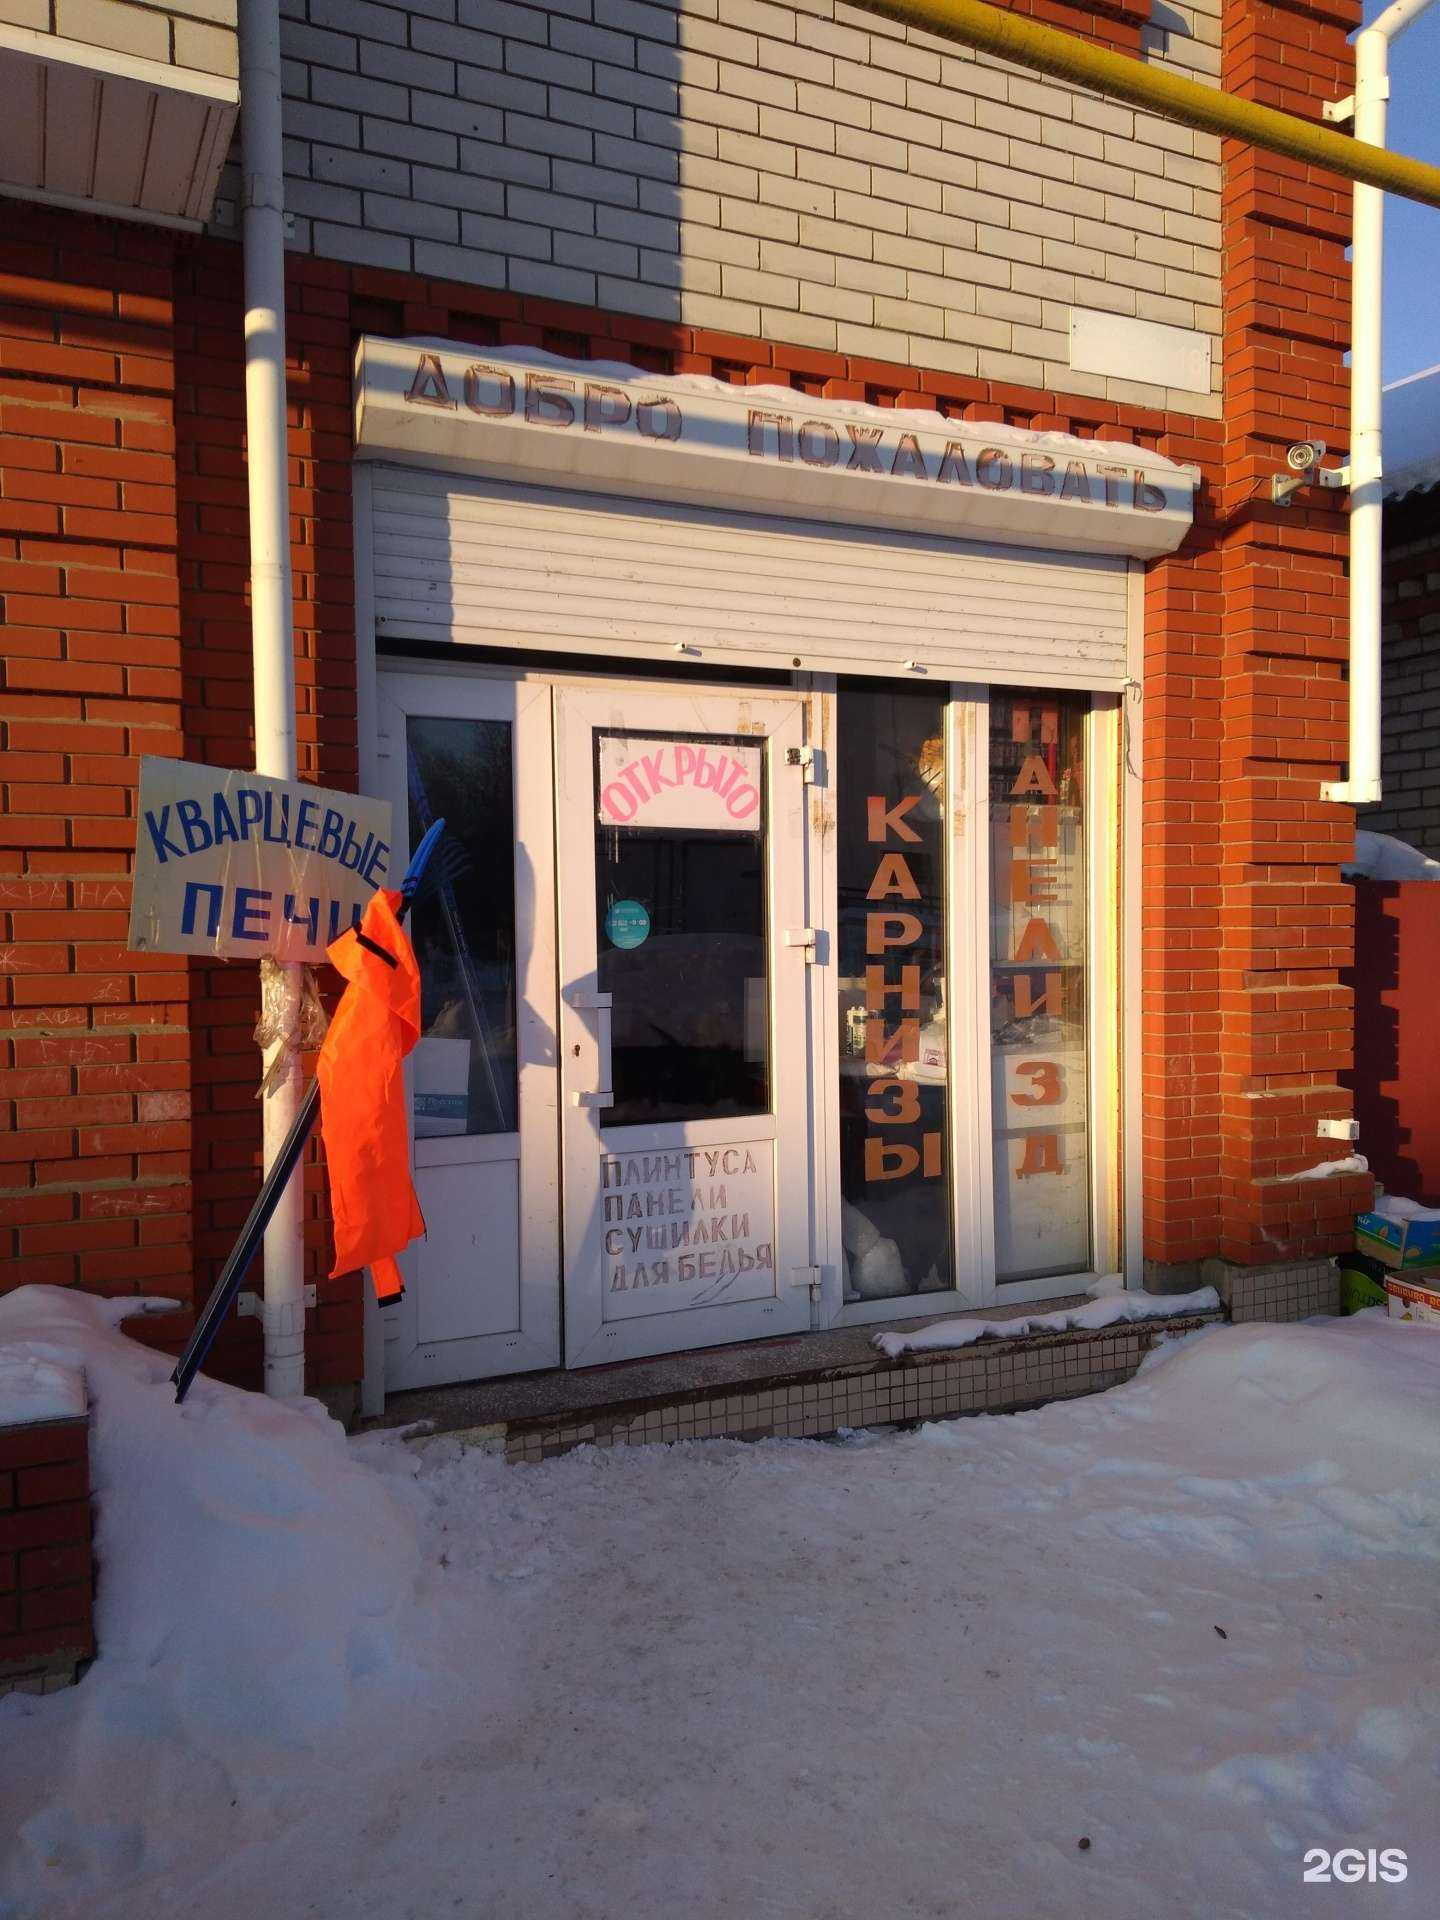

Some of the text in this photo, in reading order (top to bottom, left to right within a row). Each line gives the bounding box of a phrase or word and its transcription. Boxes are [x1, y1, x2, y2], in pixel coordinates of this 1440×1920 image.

[404, 353, 1167, 513] ДОБРО ПОЖАЛОВАТЬ
[602, 745, 759, 822] ОТКРЫТО
[145, 789, 390, 890] КВАРЦЕВЫЕ
[864, 795, 942, 1182] КАРНИЗЫ
[602, 1149, 757, 1188] ПЛИНТУСА
[604, 1184, 728, 1222] ПАНЕЛИ
[605, 1213, 750, 1256] СУШИЛКИ
[610, 1243, 772, 1293] ДЛЯ БЕЛЬЯ
